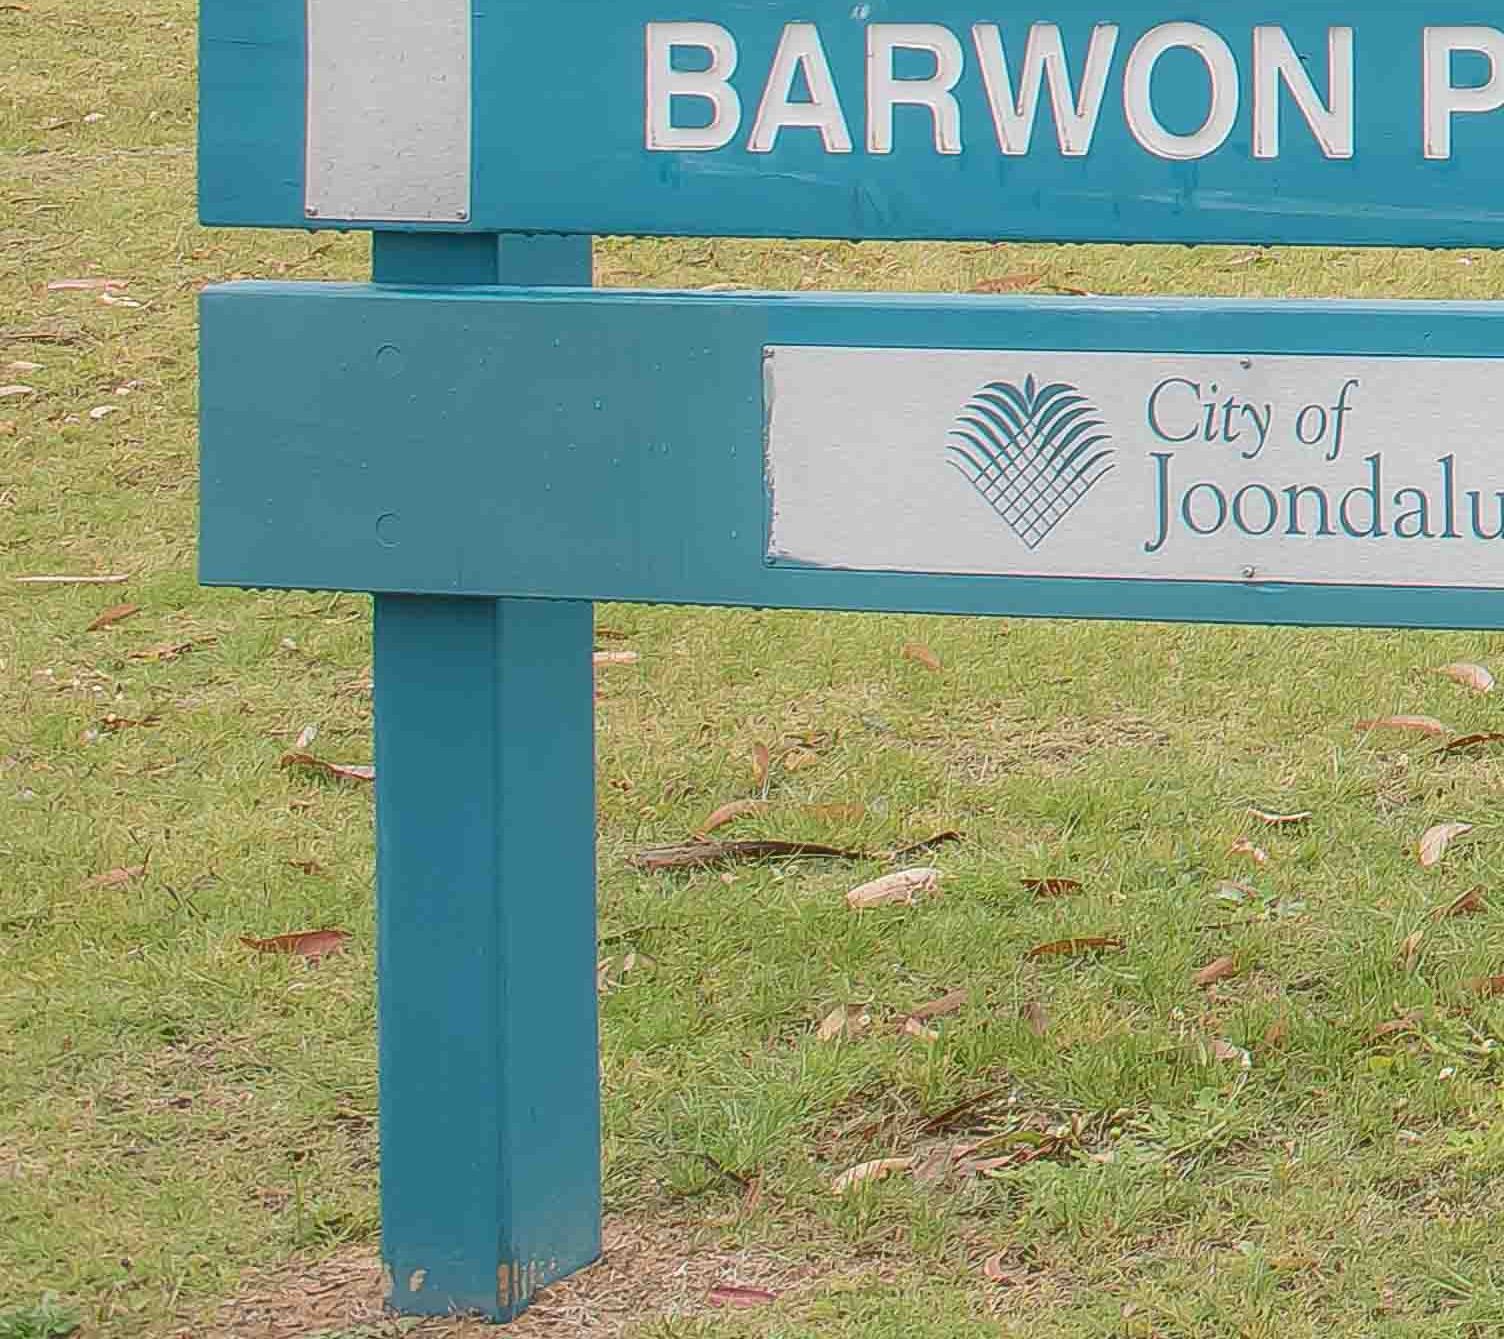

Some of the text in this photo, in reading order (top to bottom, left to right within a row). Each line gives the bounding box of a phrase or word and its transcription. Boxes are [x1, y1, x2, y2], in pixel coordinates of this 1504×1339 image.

[645, 20, 1356, 161] BARWON
[1146, 377, 1361, 462] City of
